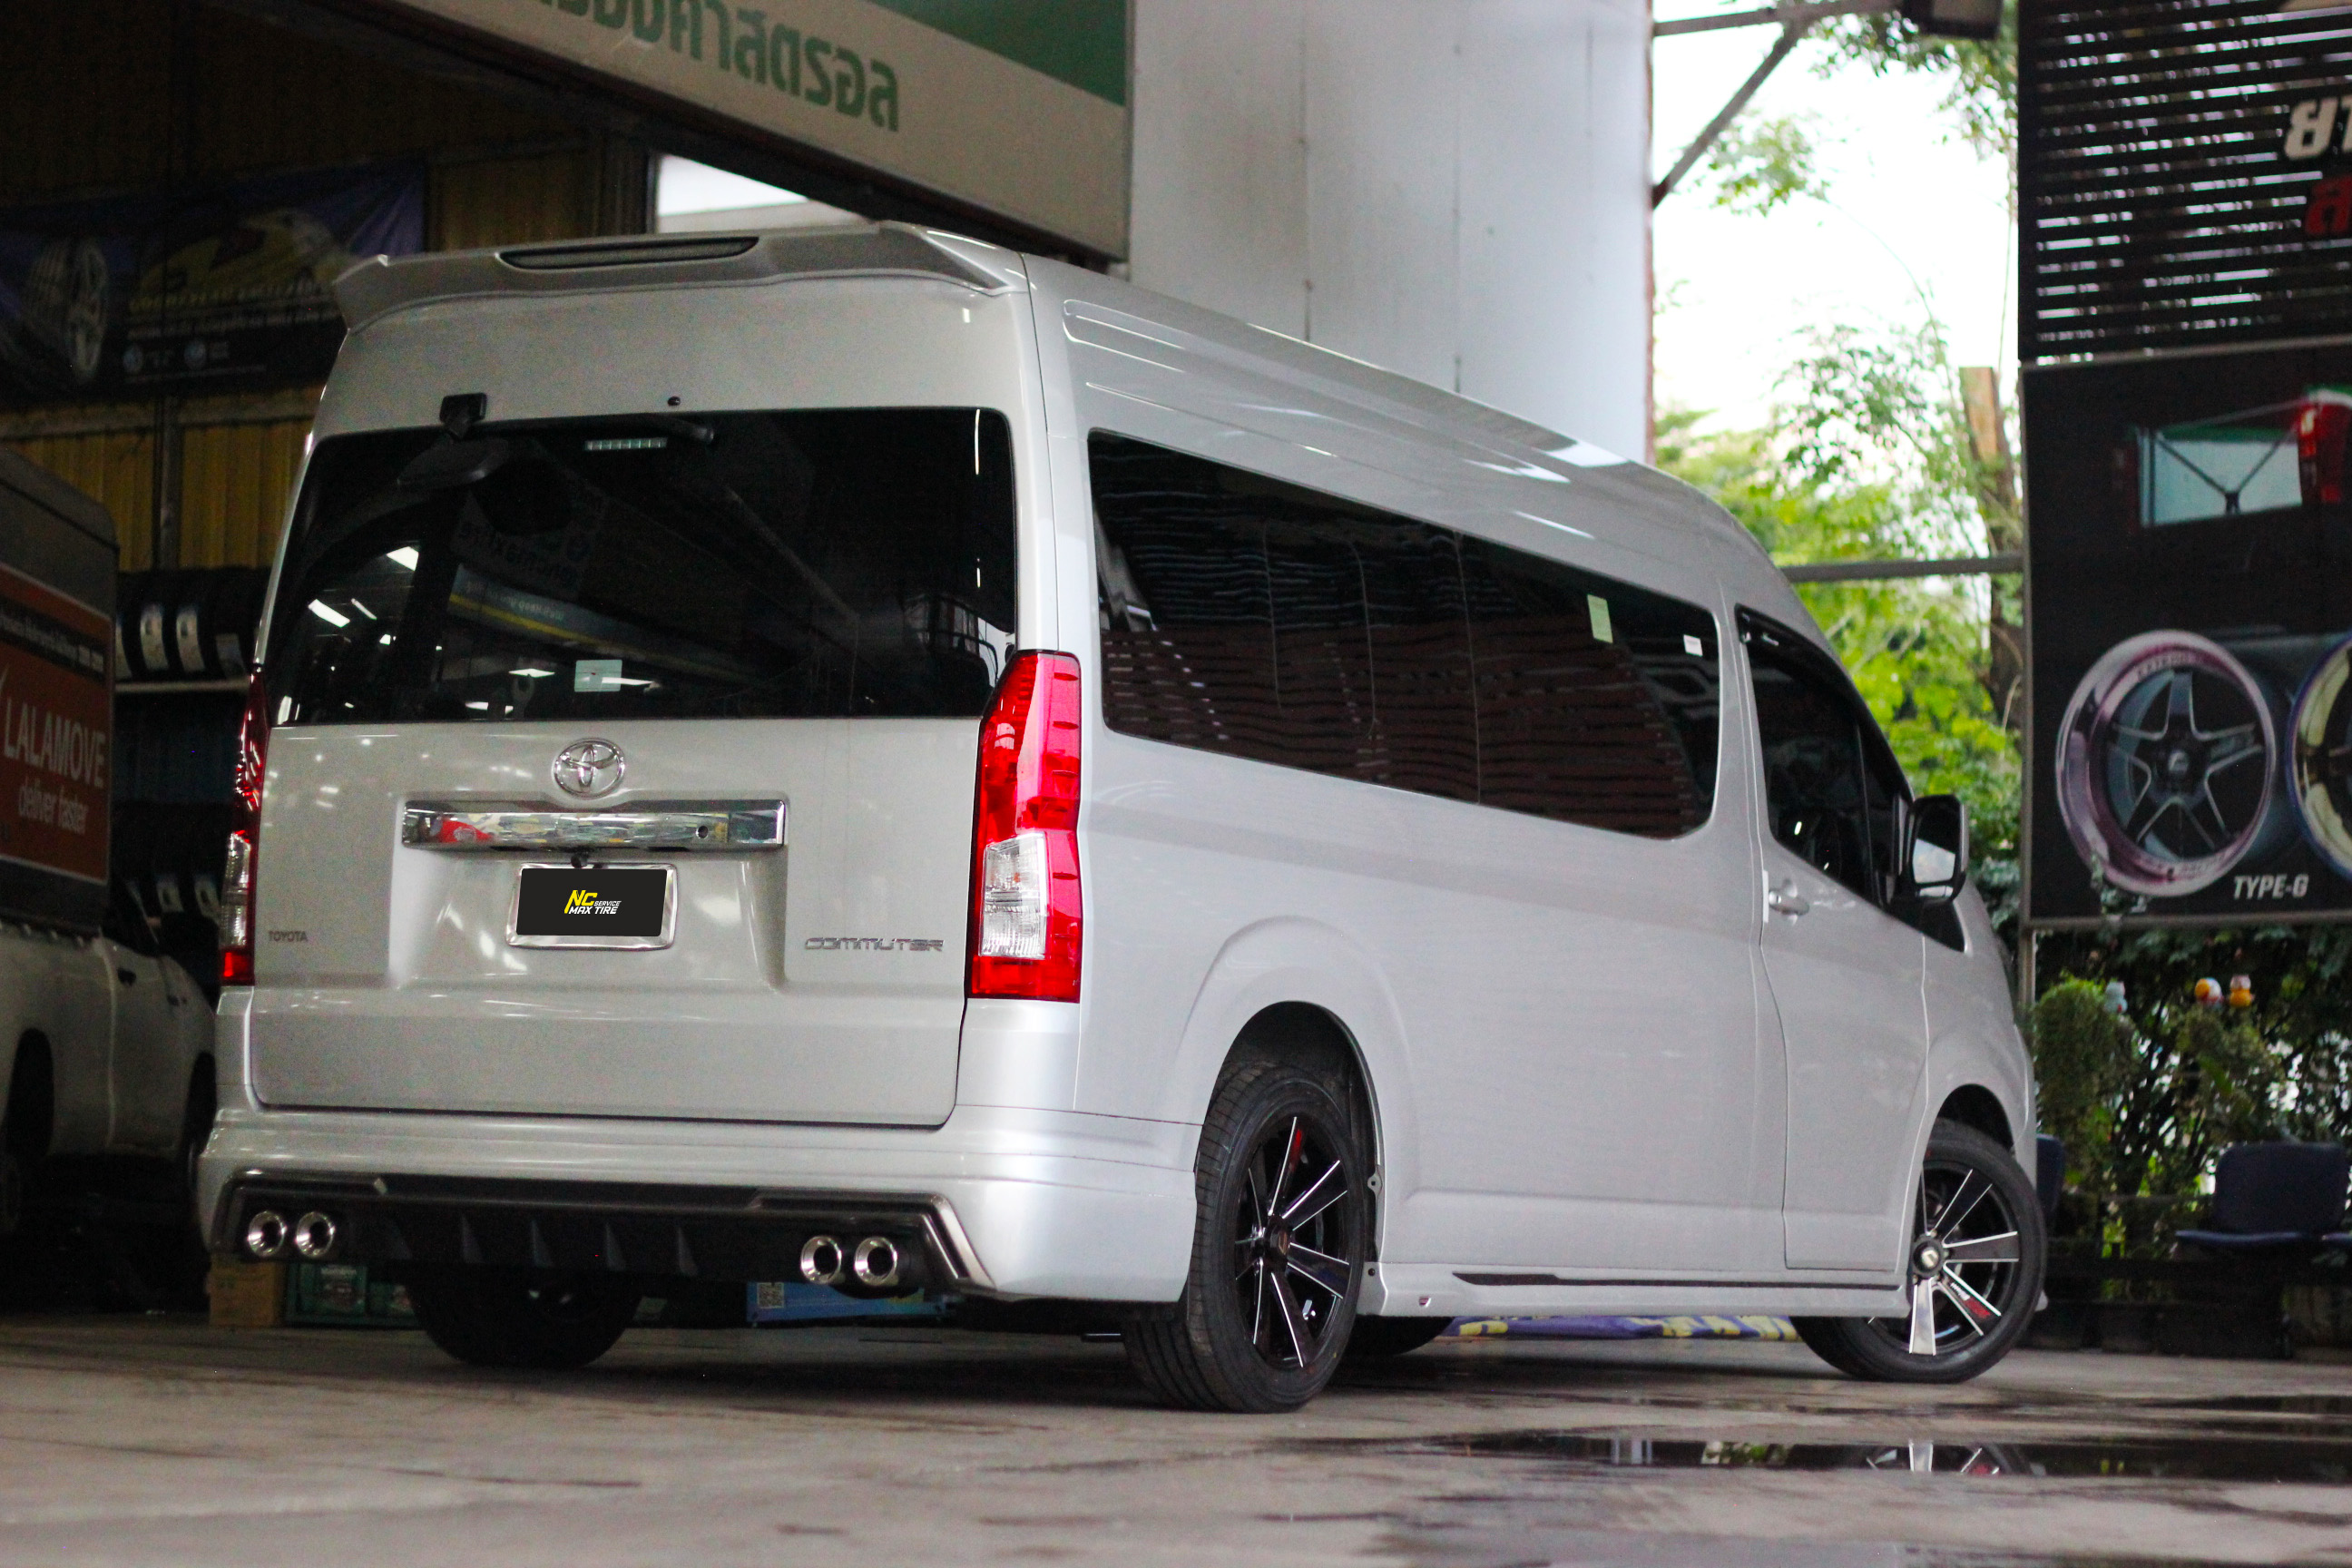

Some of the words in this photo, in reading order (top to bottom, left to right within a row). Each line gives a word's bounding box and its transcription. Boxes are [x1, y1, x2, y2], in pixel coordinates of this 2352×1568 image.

[4, 697, 105, 789] LALAMOVE
[269, 930, 309, 943] TOYOTA
[804, 936, 945, 952] COMMUTER
